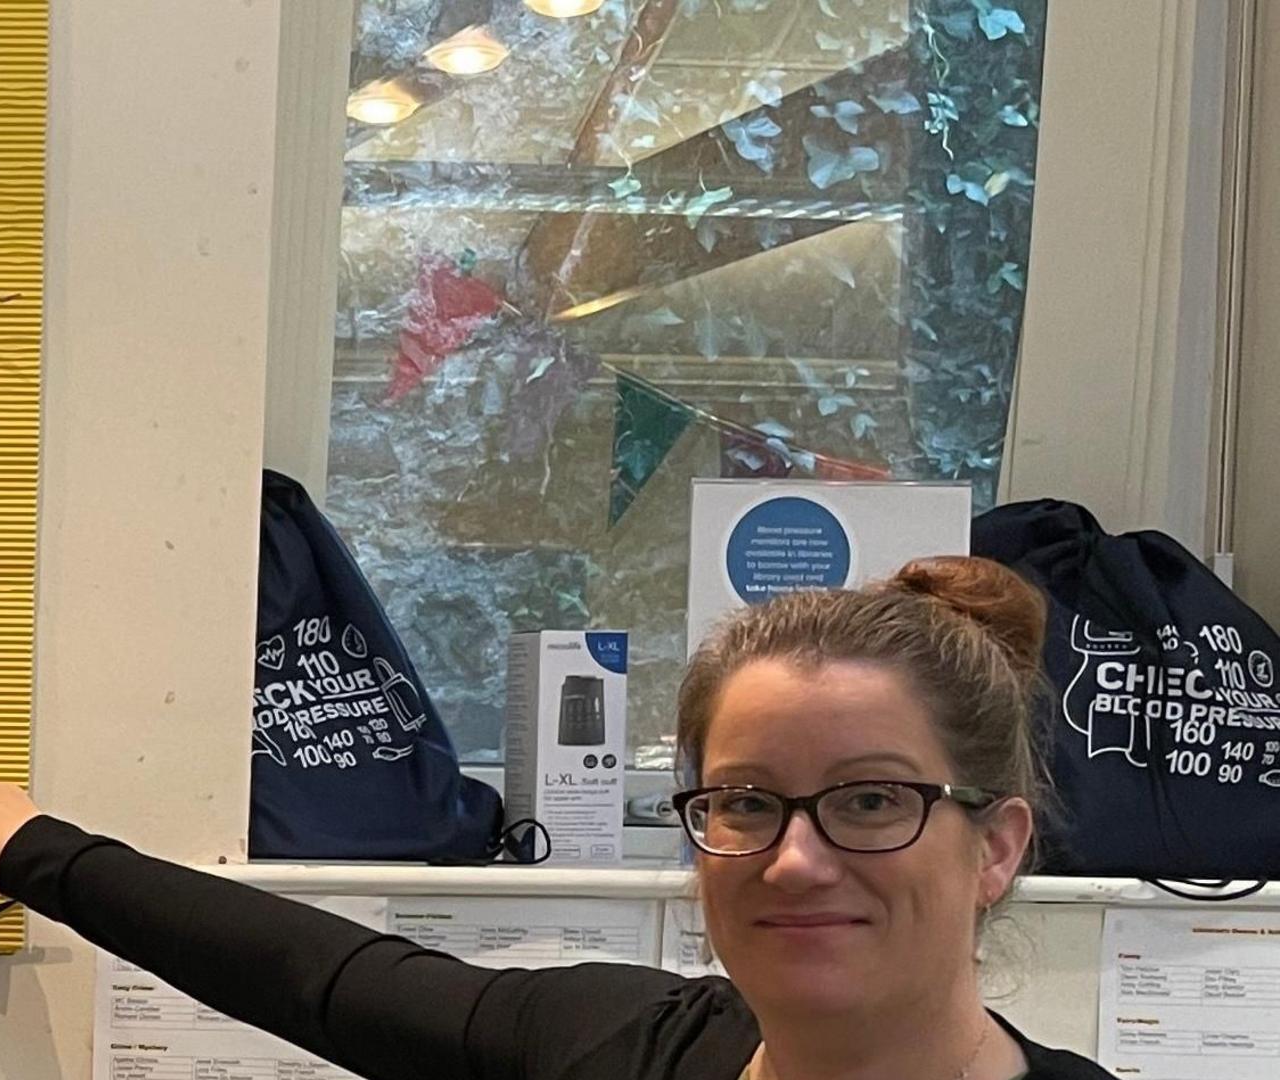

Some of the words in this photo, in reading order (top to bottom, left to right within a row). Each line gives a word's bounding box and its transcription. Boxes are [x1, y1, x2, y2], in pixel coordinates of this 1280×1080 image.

[293, 615, 331, 647] 180
[1199, 624, 1242, 654] 180
[297, 651, 340, 679] 110
[307, 669, 375, 695] YOUR
[1096, 661, 1223, 701] CHEC
[1220, 687, 1278, 709] YOUR
[292, 696, 389, 725] RESSURE
[1095, 693, 1184, 720] BLOOD
[1190, 704, 1280, 730] PRESSUR
[323, 729, 354, 750] 140
[1170, 718, 1216, 745] 160
[293, 744, 332, 769] 100
[333, 751, 357, 769] 90
[1165, 749, 1212, 776] 100
[1221, 741, 1255, 761] 140
[544, 773, 577, 786] L-XL
[1218, 764, 1242, 783] 90
